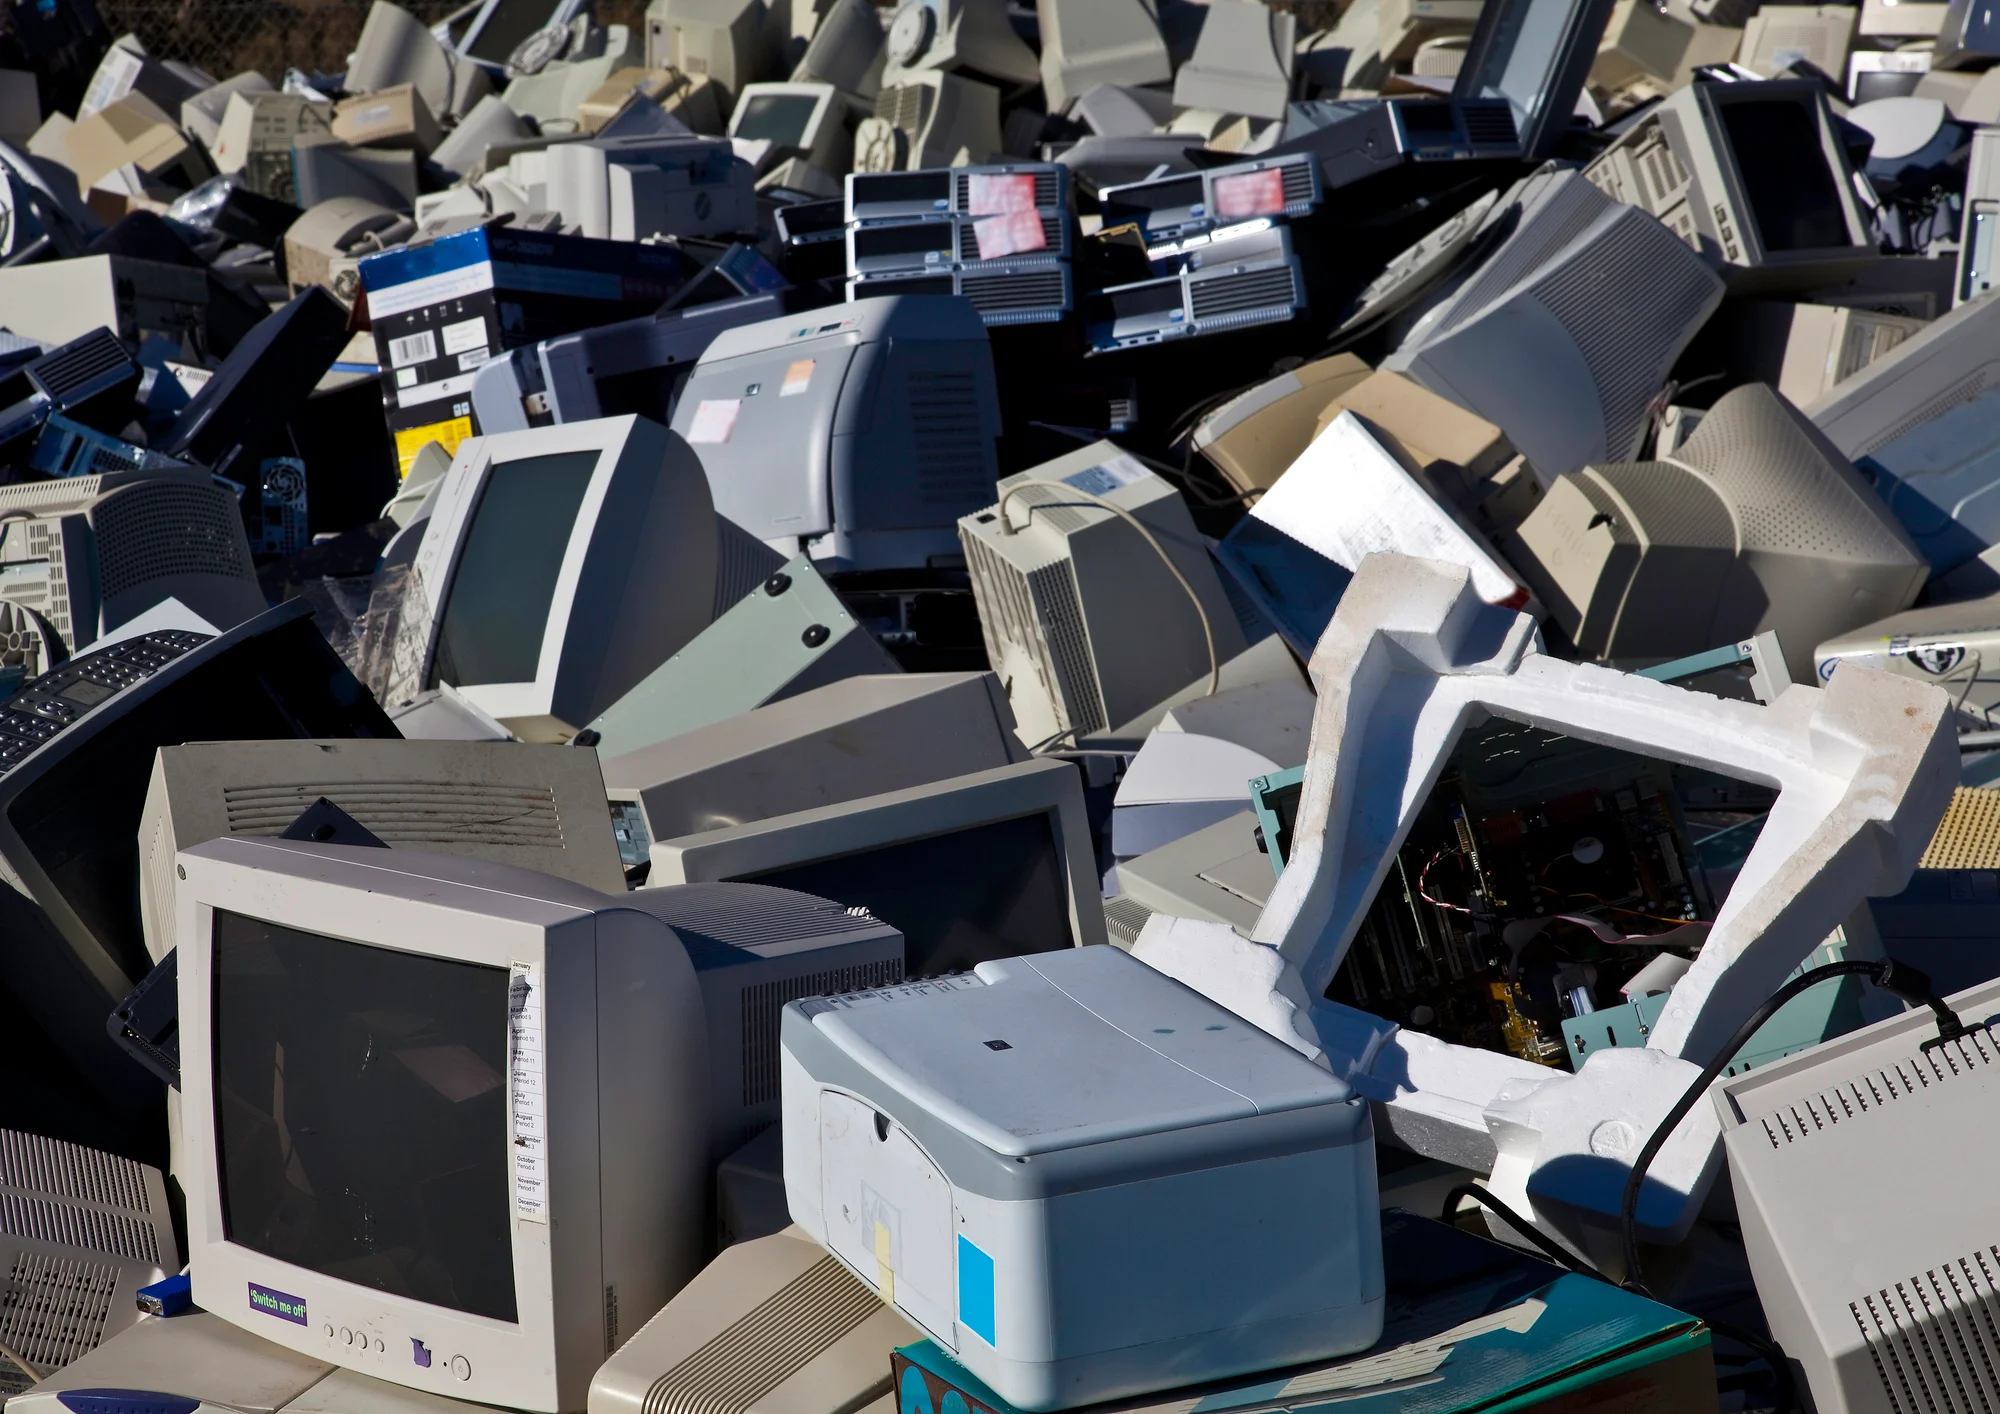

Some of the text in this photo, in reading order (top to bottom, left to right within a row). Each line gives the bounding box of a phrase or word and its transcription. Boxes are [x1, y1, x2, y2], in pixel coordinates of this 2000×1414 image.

[512, 961, 531, 971] January
[512, 1028, 525, 1036] April
[512, 1034, 529, 1042] Period
[513, 1055, 529, 1063] Period
[513, 1077, 530, 1085] Period
[514, 1091, 526, 1099] July
[514, 1098, 530, 1106] Period
[515, 1112, 533, 1121] August
[515, 1119, 531, 1128] Period
[516, 1155, 536, 1164] October
[517, 1162, 531, 1171] Period
[517, 1176, 541, 1186] November
[517, 1183, 532, 1192] Period
[517, 1197, 541, 1208] December
[518, 1204, 532, 1213] Period
[279, 1301, 292, 1314] me
